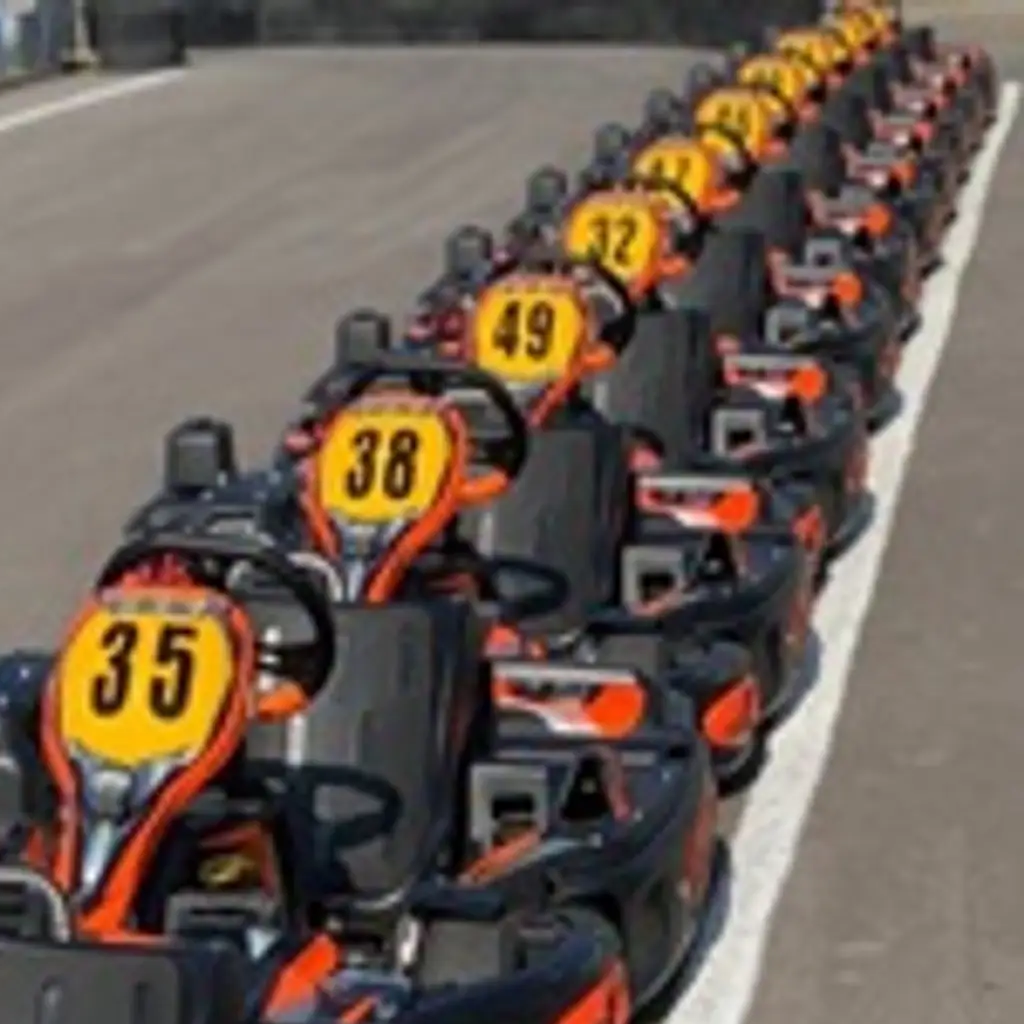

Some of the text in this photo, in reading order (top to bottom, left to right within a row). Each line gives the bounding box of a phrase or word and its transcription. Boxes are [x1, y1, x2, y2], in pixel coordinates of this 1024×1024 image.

[491, 300, 556, 361] 49
[346, 426, 419, 500] 38
[89, 620, 198, 720] 35
